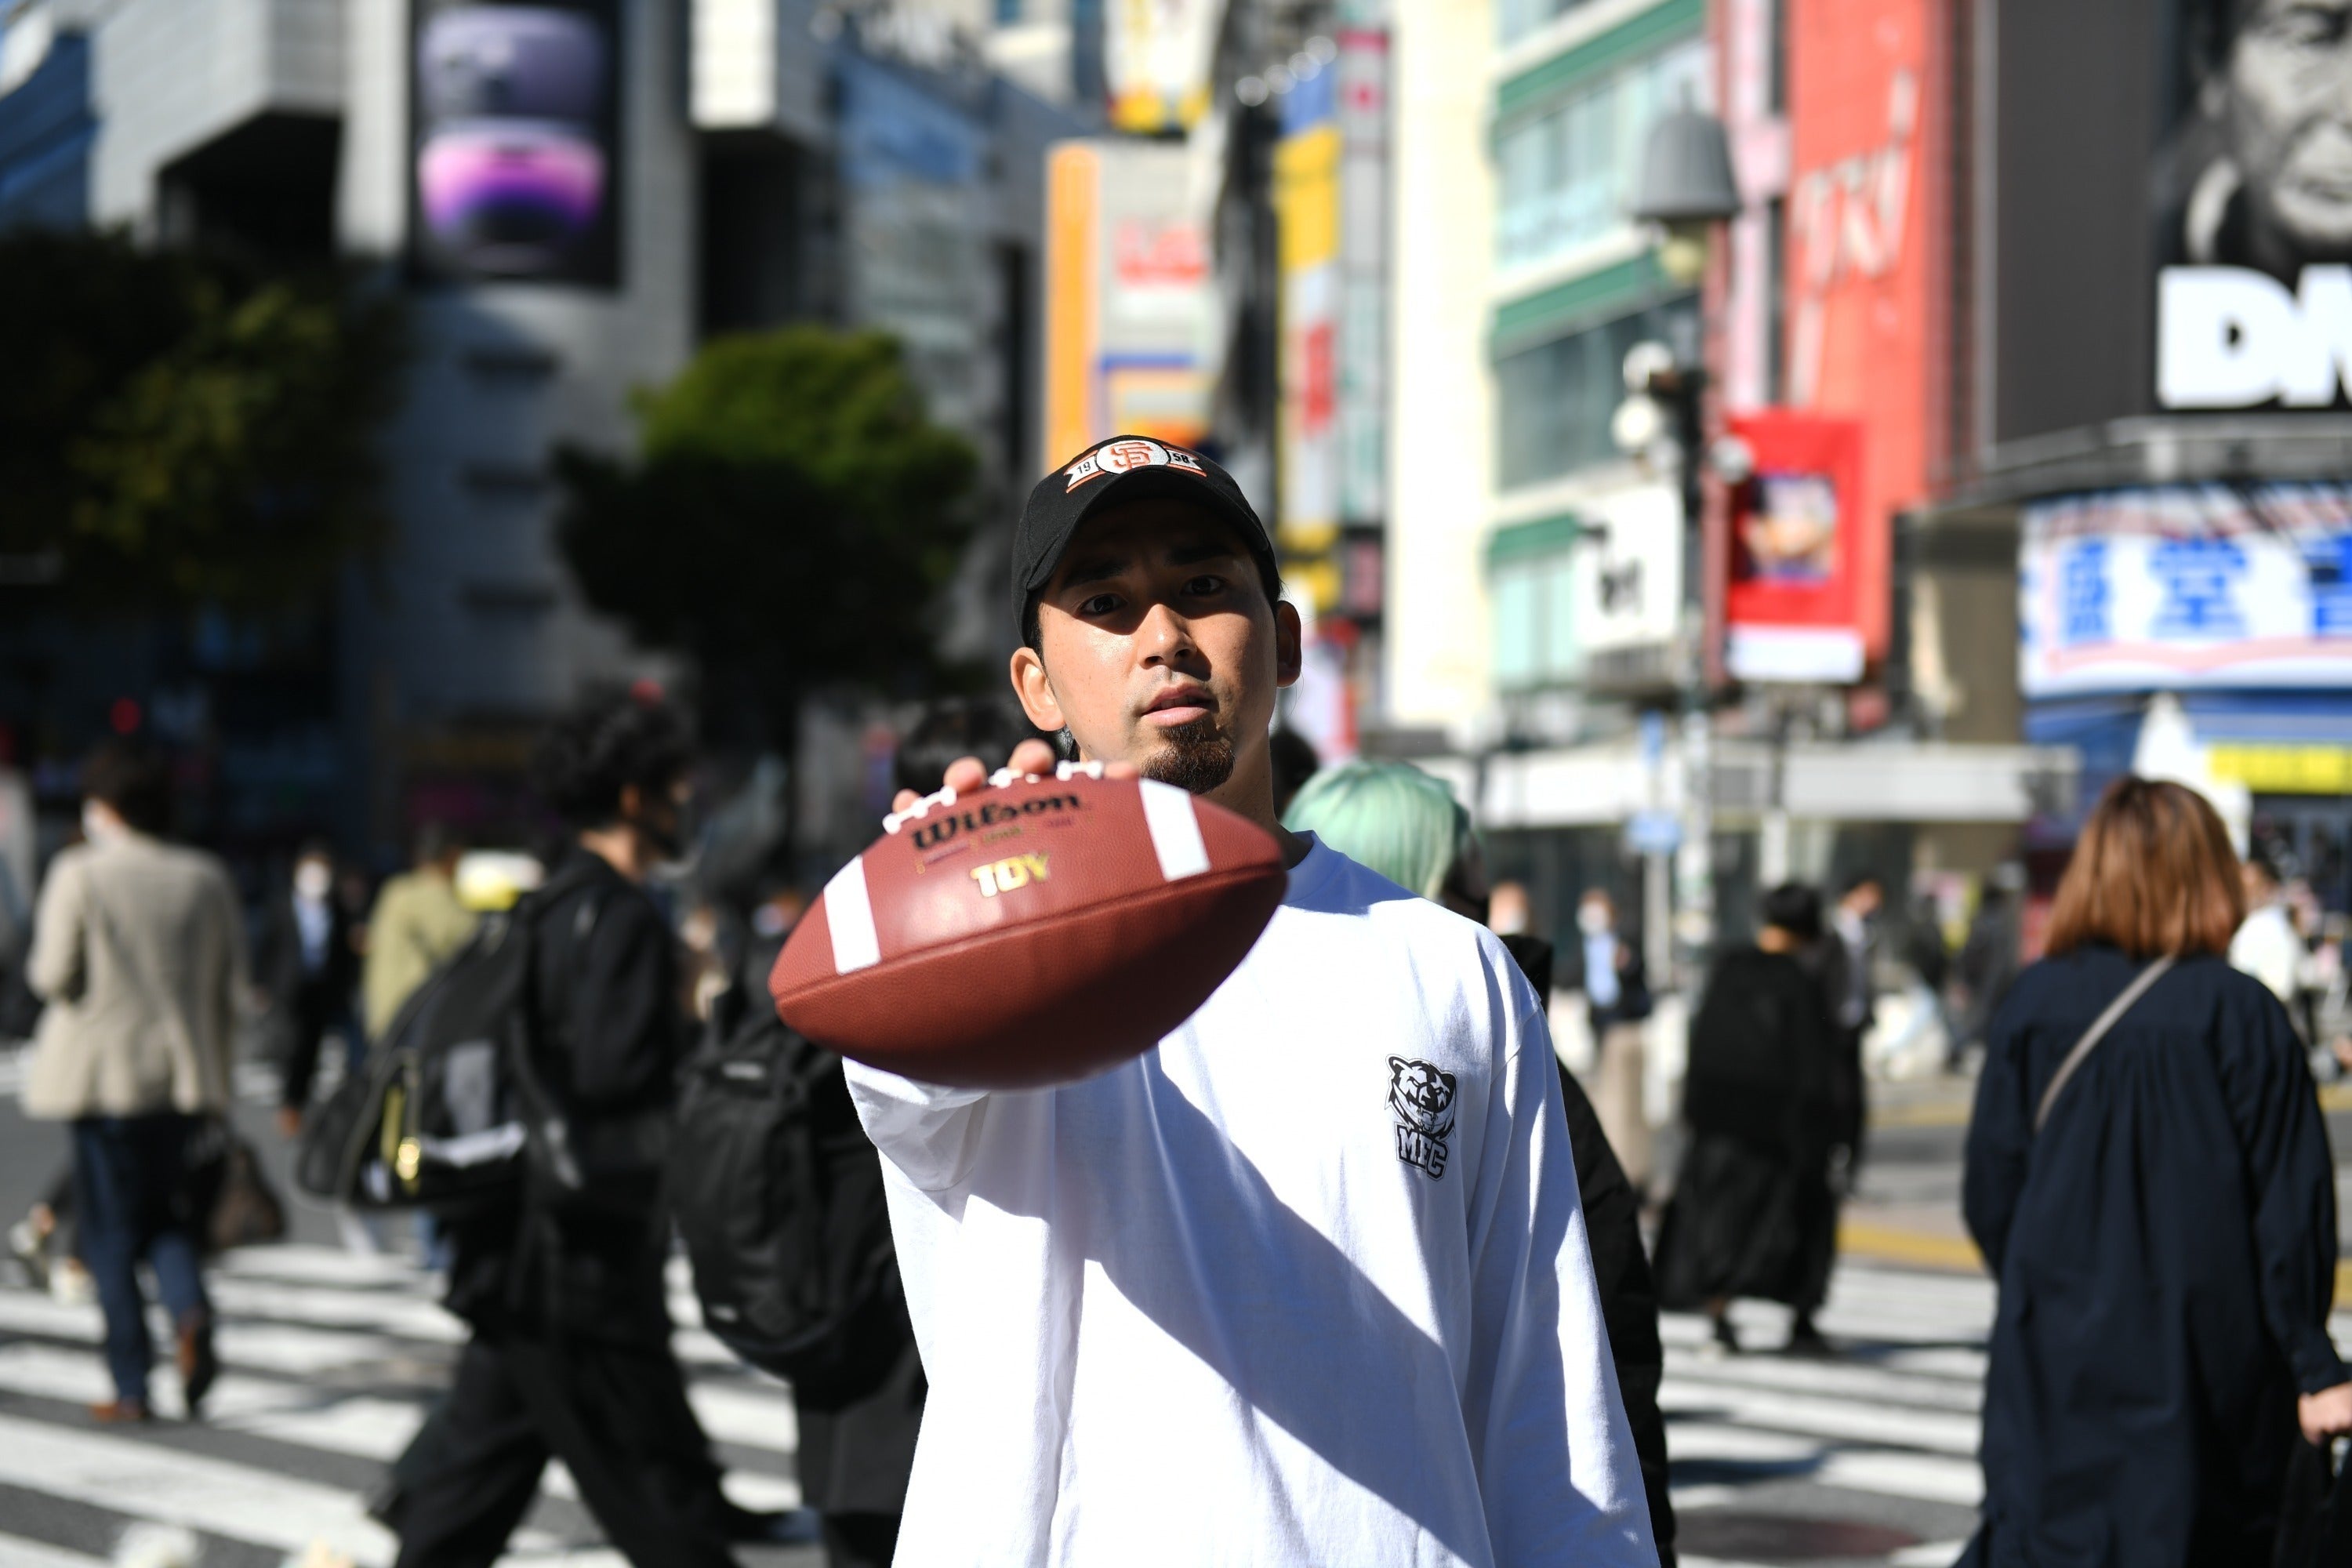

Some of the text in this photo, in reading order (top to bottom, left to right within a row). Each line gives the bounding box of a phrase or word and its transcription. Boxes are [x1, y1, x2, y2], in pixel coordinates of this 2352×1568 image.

[1076, 461, 1091, 474] 19
[1173, 452, 1190, 464] 58
[912, 794, 1081, 849] Wilson
